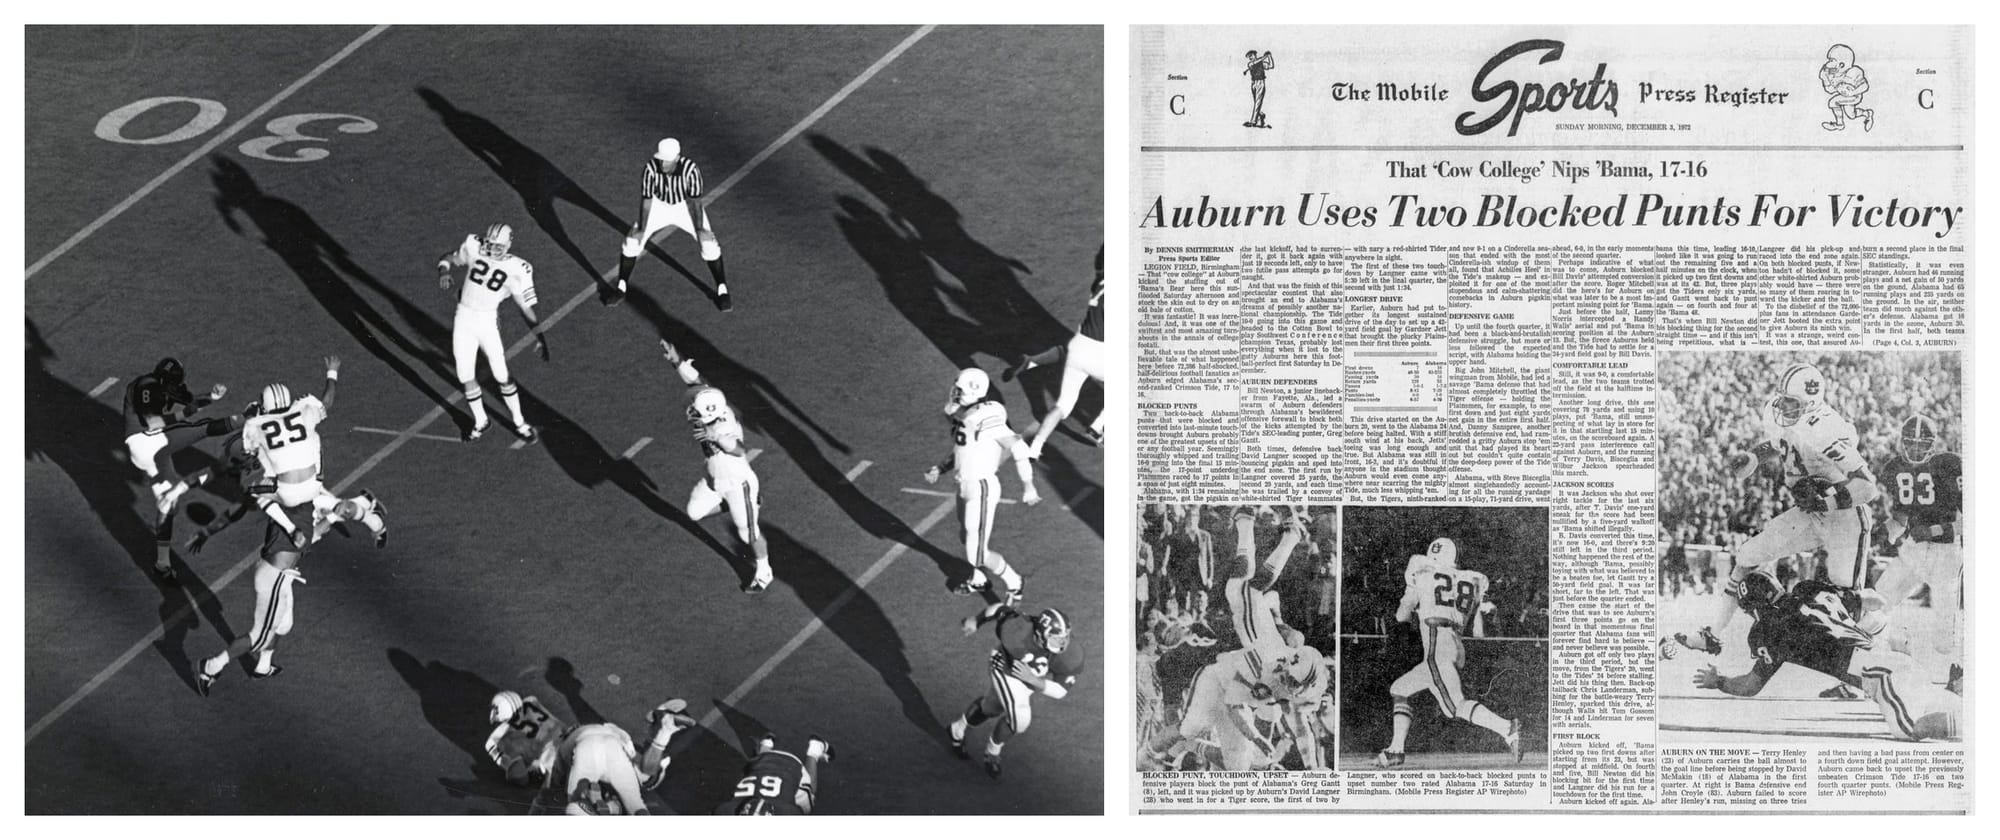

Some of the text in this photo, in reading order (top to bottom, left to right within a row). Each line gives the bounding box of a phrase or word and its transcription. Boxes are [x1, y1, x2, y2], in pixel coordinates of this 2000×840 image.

[1332, 82, 1448, 101] The Mobile
[1455, 38, 1620, 137] Sports
[1639, 82, 1789, 108] Press Register
[1918, 89, 1934, 109] C
[1170, 95, 1185, 115] C
[94, 96, 379, 162] 30
[1139, 193, 1963, 238] Auburn Uses Two Blocked Punts For Victory
[469, 260, 508, 292] 28
[142, 389, 150, 403] 8
[261, 412, 307, 449] 25
[1896, 472, 1935, 506] 83
[1434, 572, 1475, 614] 28
[735, 775, 783, 798] 59
[1142, 772, 1288, 780] BLOCKED PUNT, TOUCHDOWN, UPSET
[1347, 772, 1377, 780] Langner,
